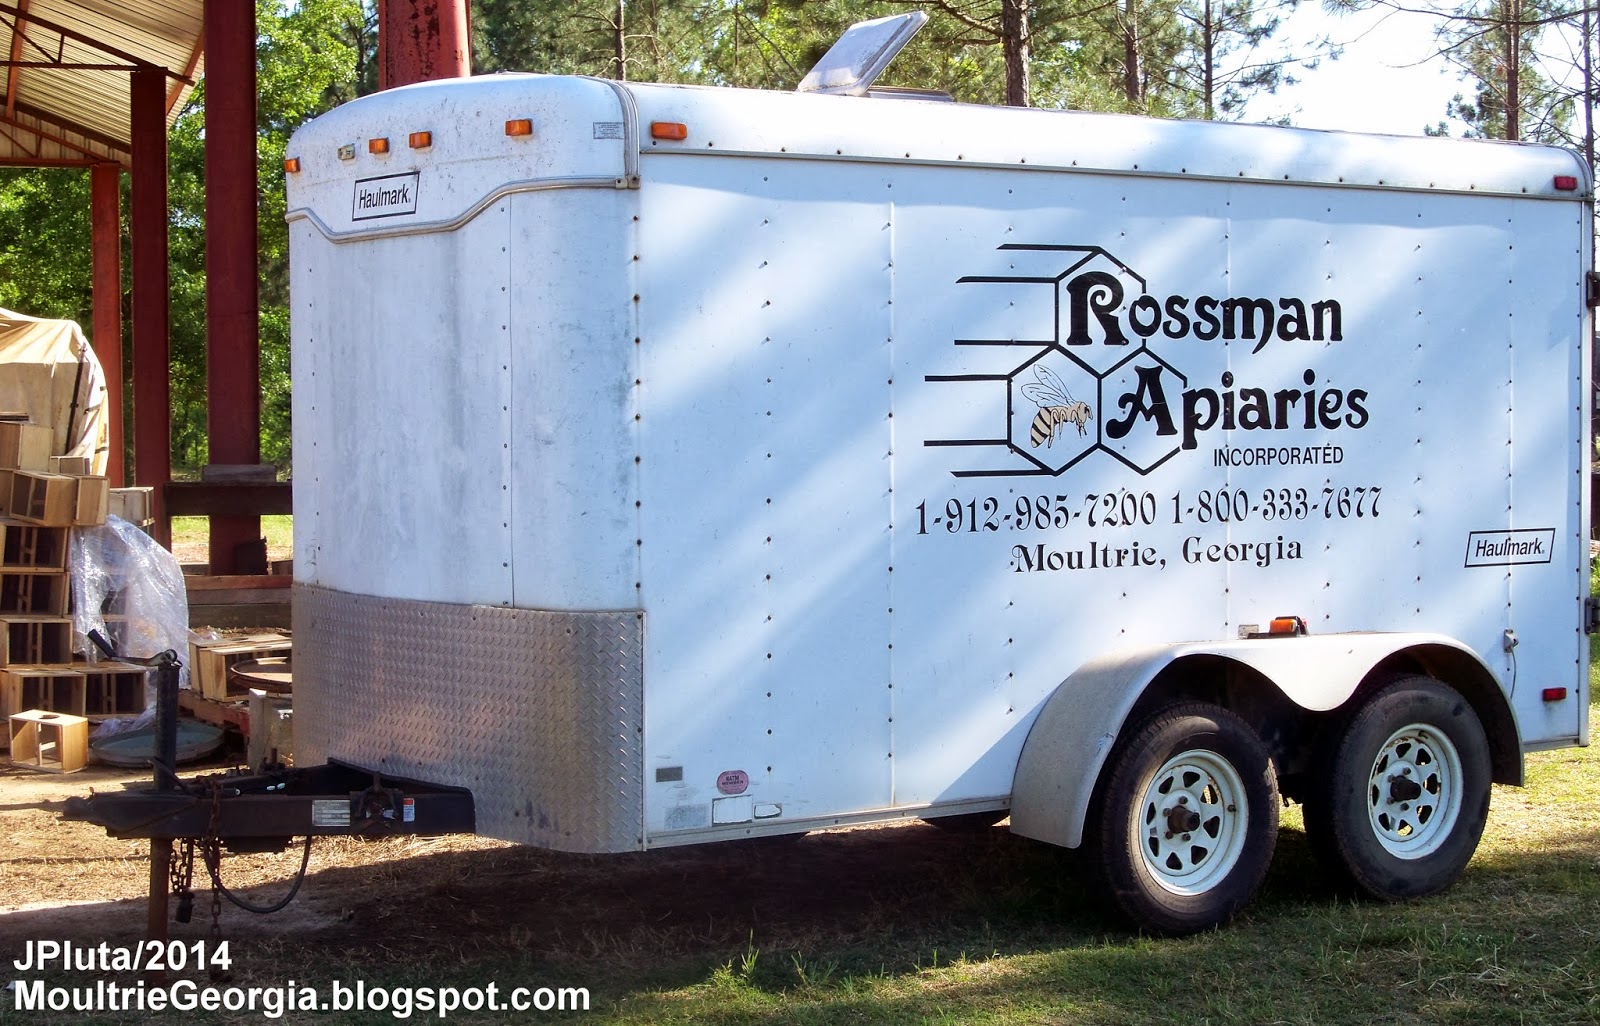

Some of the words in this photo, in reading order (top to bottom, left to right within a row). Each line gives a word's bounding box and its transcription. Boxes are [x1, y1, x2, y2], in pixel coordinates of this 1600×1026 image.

[1066, 270, 1344, 355] Rossman
[1105, 365, 1369, 450] Apiaries
[1213, 446, 1345, 467] INCORPORATED
[915, 492, 1157, 535] 1-912-985-7200
[1171, 486, 1384, 525] 1-800-333-7677
[1011, 541, 1167, 574] Moultrie,
[1181, 535, 1304, 569] Georgia
